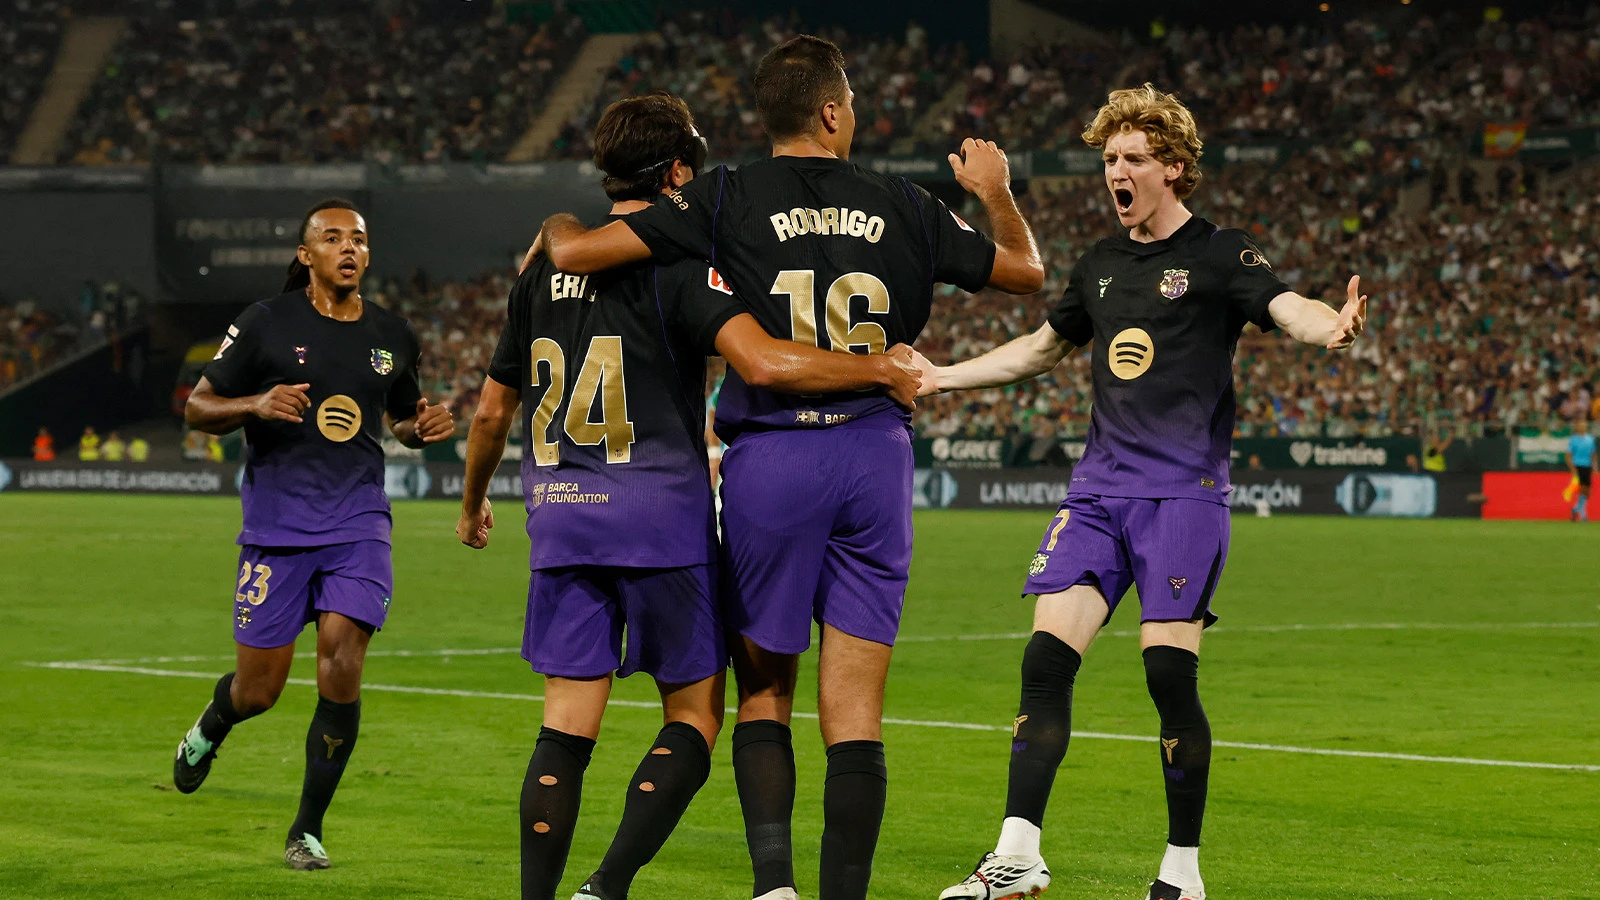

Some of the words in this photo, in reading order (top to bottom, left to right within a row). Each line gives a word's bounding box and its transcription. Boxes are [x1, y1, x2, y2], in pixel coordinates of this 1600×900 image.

[668, 190, 689, 211] dea
[769, 207, 885, 243] RODRIGO
[551, 272, 597, 302] ERI
[769, 269, 890, 355] 16
[531, 336, 635, 466] 24
[825, 414, 857, 424] BAR
[951, 440, 1001, 461] GREE
[1313, 442, 1387, 466] trainline
[546, 493, 609, 504] FOUNDATION
[548, 482, 579, 494] BARÇA
[980, 482, 1004, 504] LA
[1046, 509, 1070, 551] 7
[235, 560, 272, 606] 23
